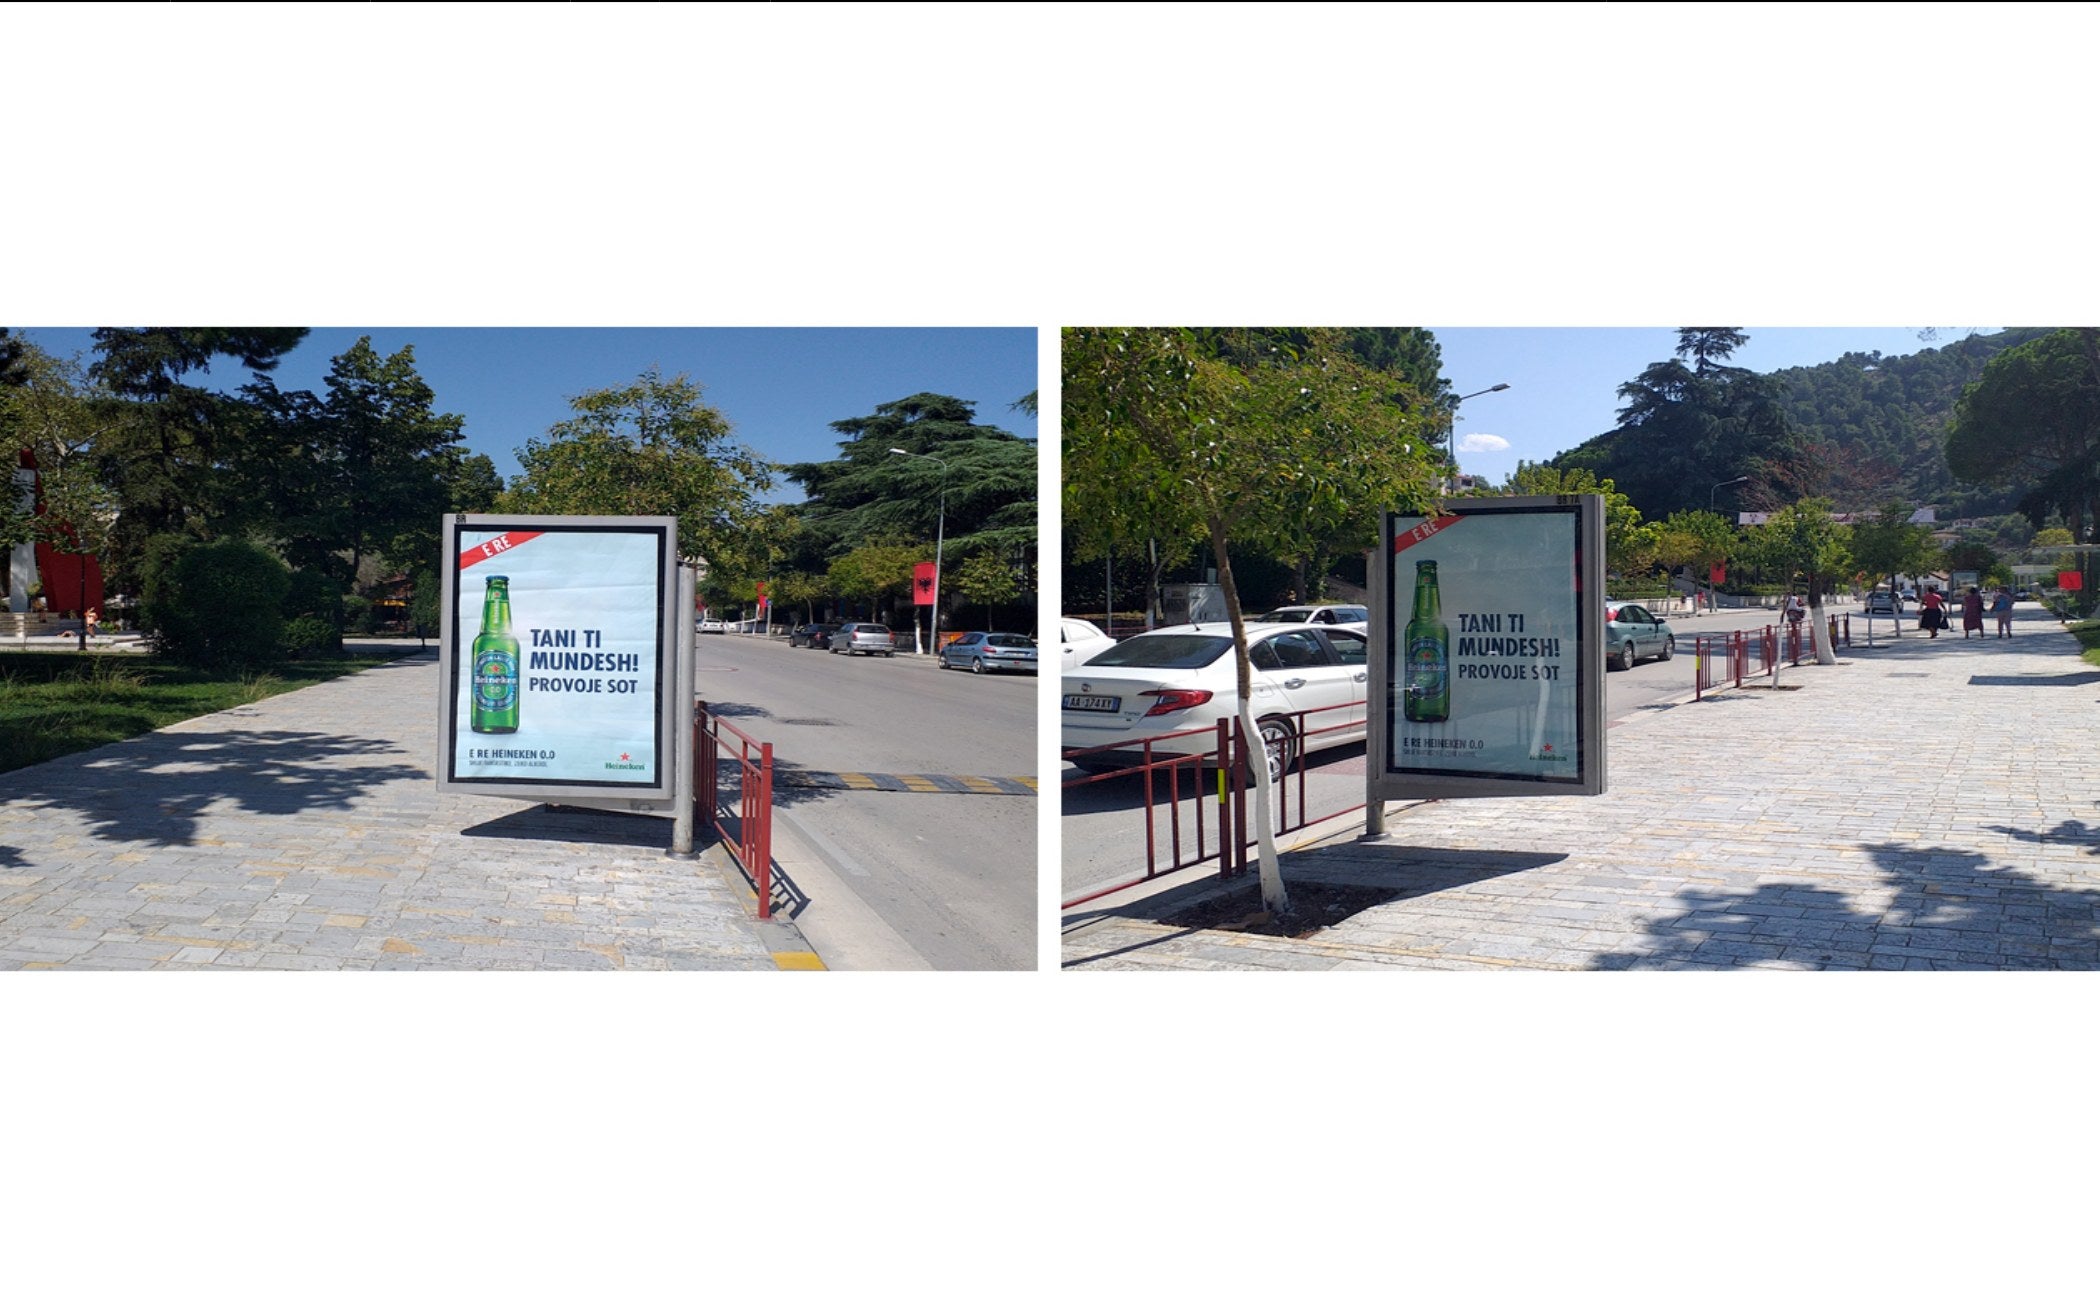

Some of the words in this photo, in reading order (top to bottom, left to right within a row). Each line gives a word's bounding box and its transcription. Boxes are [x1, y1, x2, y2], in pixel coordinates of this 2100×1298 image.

[1412, 529, 1422, 541] E
[1421, 520, 1438, 536] RE
[481, 543, 493, 557] E
[492, 535, 512, 553] RE
[1458, 613, 1501, 633] TANI
[1508, 613, 1524, 633] TI
[530, 628, 576, 648] TANI
[583, 629, 601, 648] TI
[1458, 637, 1560, 658] MUNDESH!
[529, 651, 639, 672] MUNDESH!
[473, 674, 518, 685] Heineken
[1458, 663, 1526, 680] PROVOJE
[1531, 664, 1560, 681] SOT
[529, 676, 602, 693] PROVOJE
[607, 678, 638, 694] SOT
[1403, 737, 1409, 747] E
[1411, 738, 1421, 748] RE
[1424, 738, 1467, 749] HEINEKEN
[1469, 739, 1484, 750] 0.0
[469, 748, 475, 759] E
[477, 749, 489, 759] RE
[492, 749, 537, 760] HEINEKEN
[539, 749, 556, 760] 0.0
[605, 762, 646, 771] Heineken
